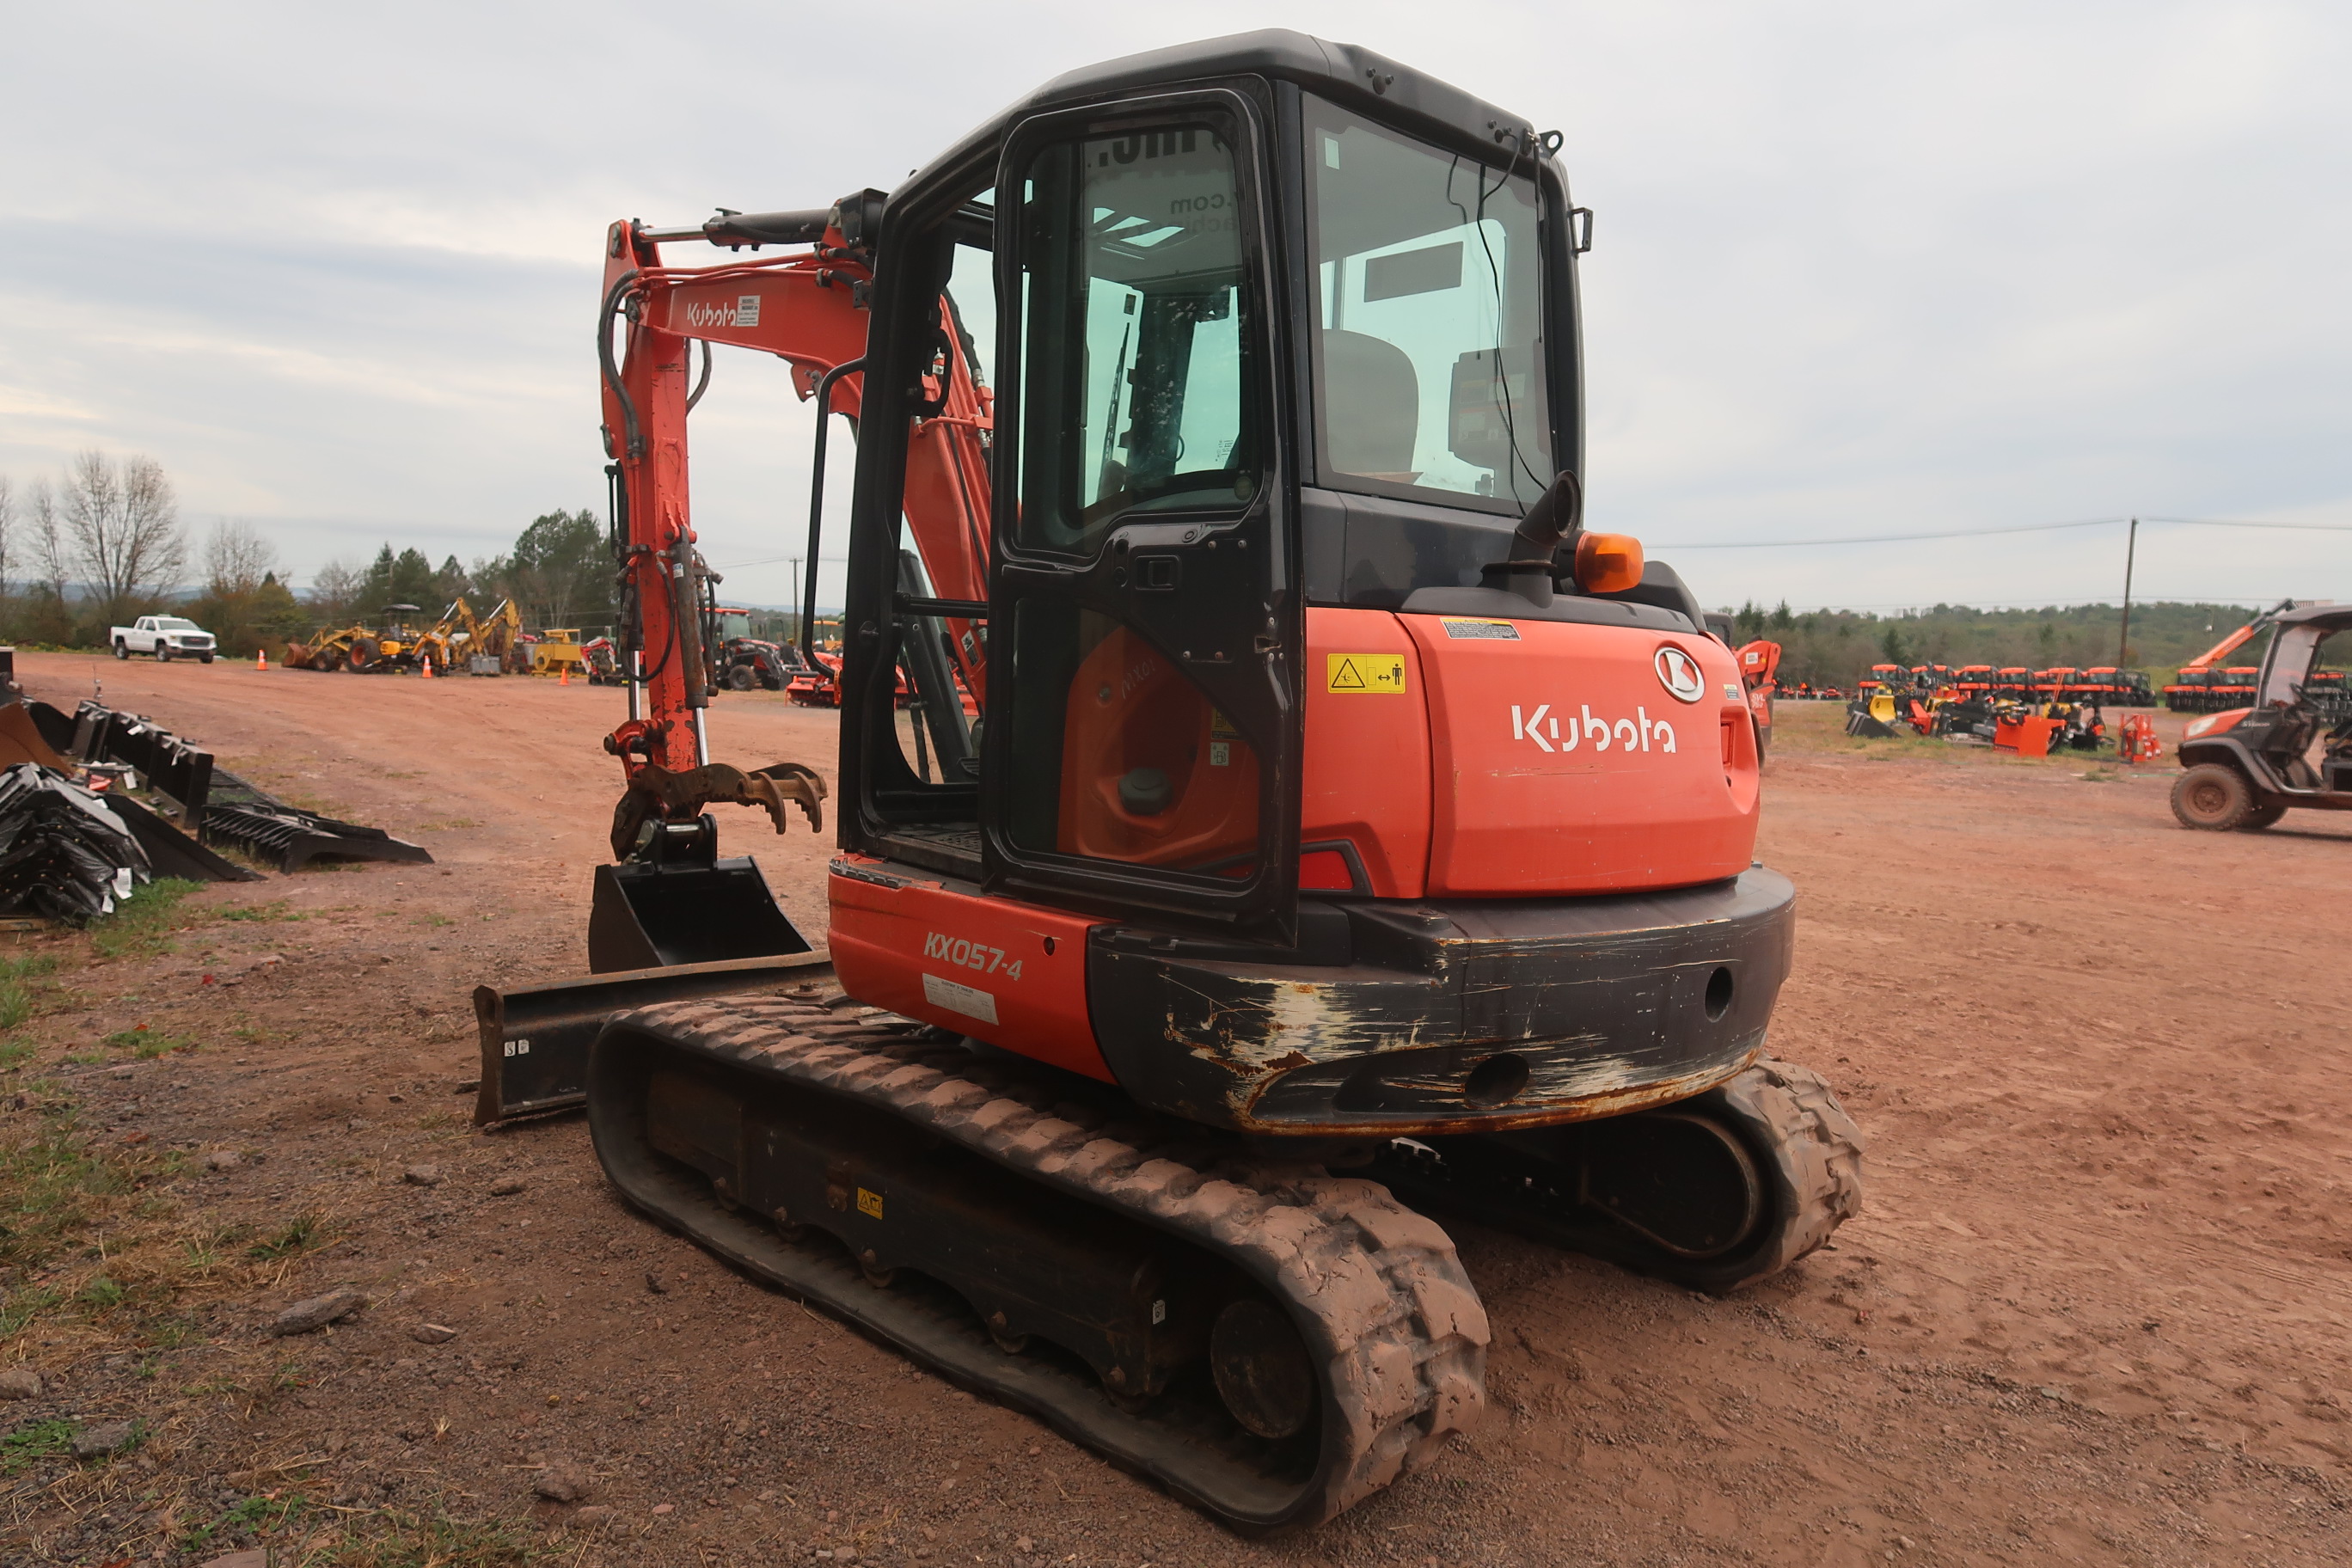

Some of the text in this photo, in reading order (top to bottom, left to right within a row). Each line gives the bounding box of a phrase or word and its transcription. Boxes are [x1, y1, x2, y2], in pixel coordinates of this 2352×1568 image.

[687, 302, 737, 328] Kubota
[1510, 703, 1677, 754] Kubota
[923, 931, 1024, 982] KX057-4
